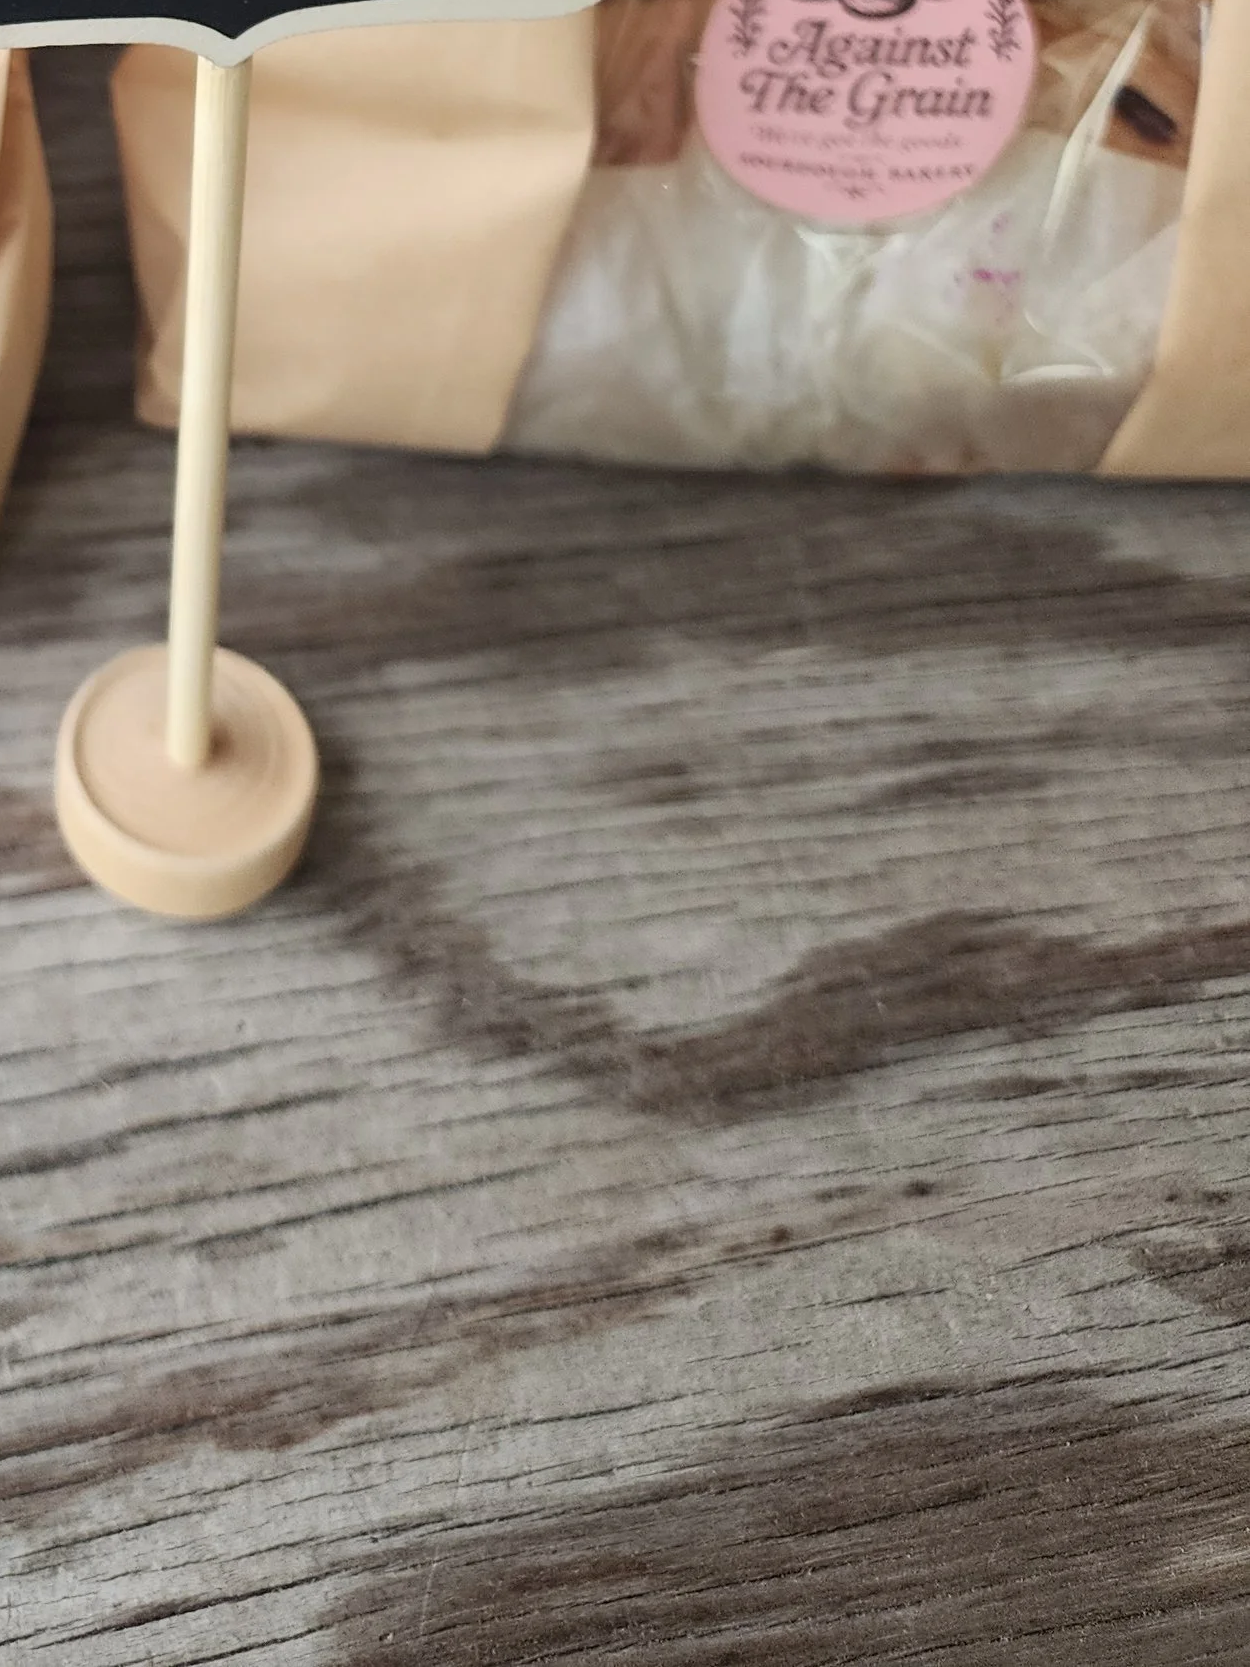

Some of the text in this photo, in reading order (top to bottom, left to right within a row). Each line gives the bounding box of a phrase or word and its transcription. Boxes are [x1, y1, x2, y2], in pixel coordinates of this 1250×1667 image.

[766, 19, 976, 78] Against
[740, 68, 993, 129] The Grain
